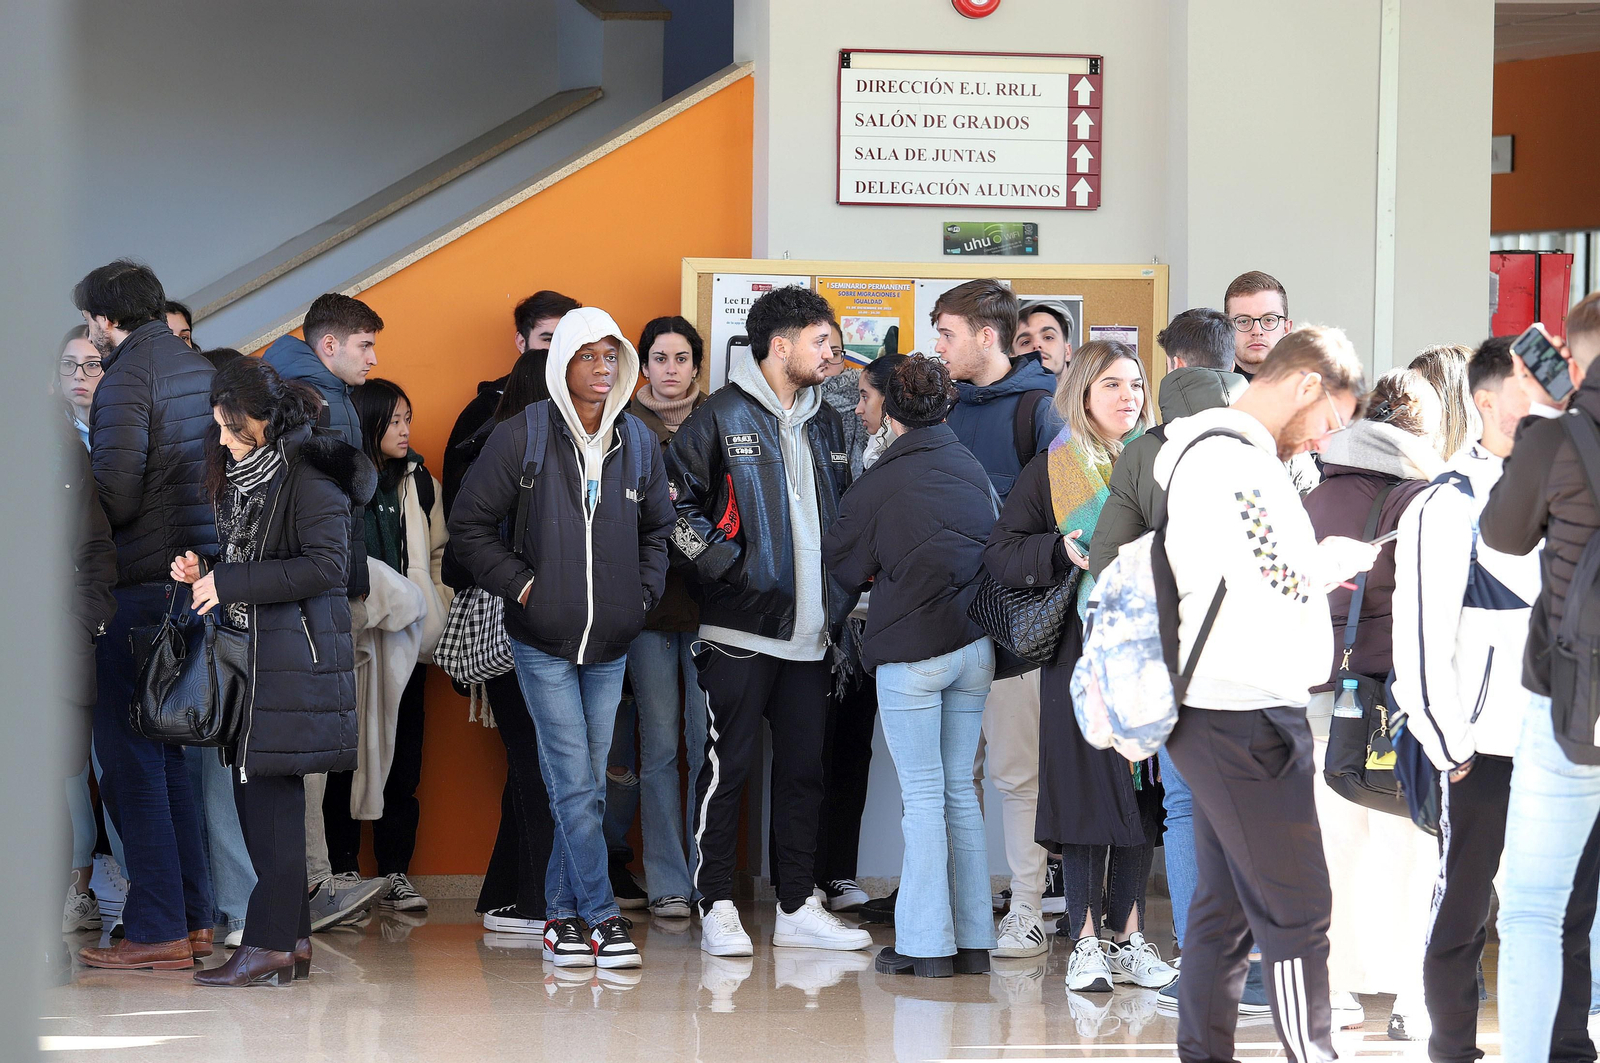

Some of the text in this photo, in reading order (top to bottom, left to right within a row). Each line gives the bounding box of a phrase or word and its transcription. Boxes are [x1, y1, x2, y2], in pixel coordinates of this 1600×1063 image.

[856, 77, 1042, 97] DIRECCIÓN E.U. RRLL
[854, 109, 1030, 130] SALÓN DE GRADOS
[854, 146, 996, 163] SALA DE JUNTAS
[855, 178, 1061, 198] DELEGACIÓN ALUMNOS
[963, 236, 991, 252] uhu
[830, 282, 867, 290] SEMINARIO
[868, 283, 911, 291] PERMANENTE
[724, 297, 739, 305] Lee
